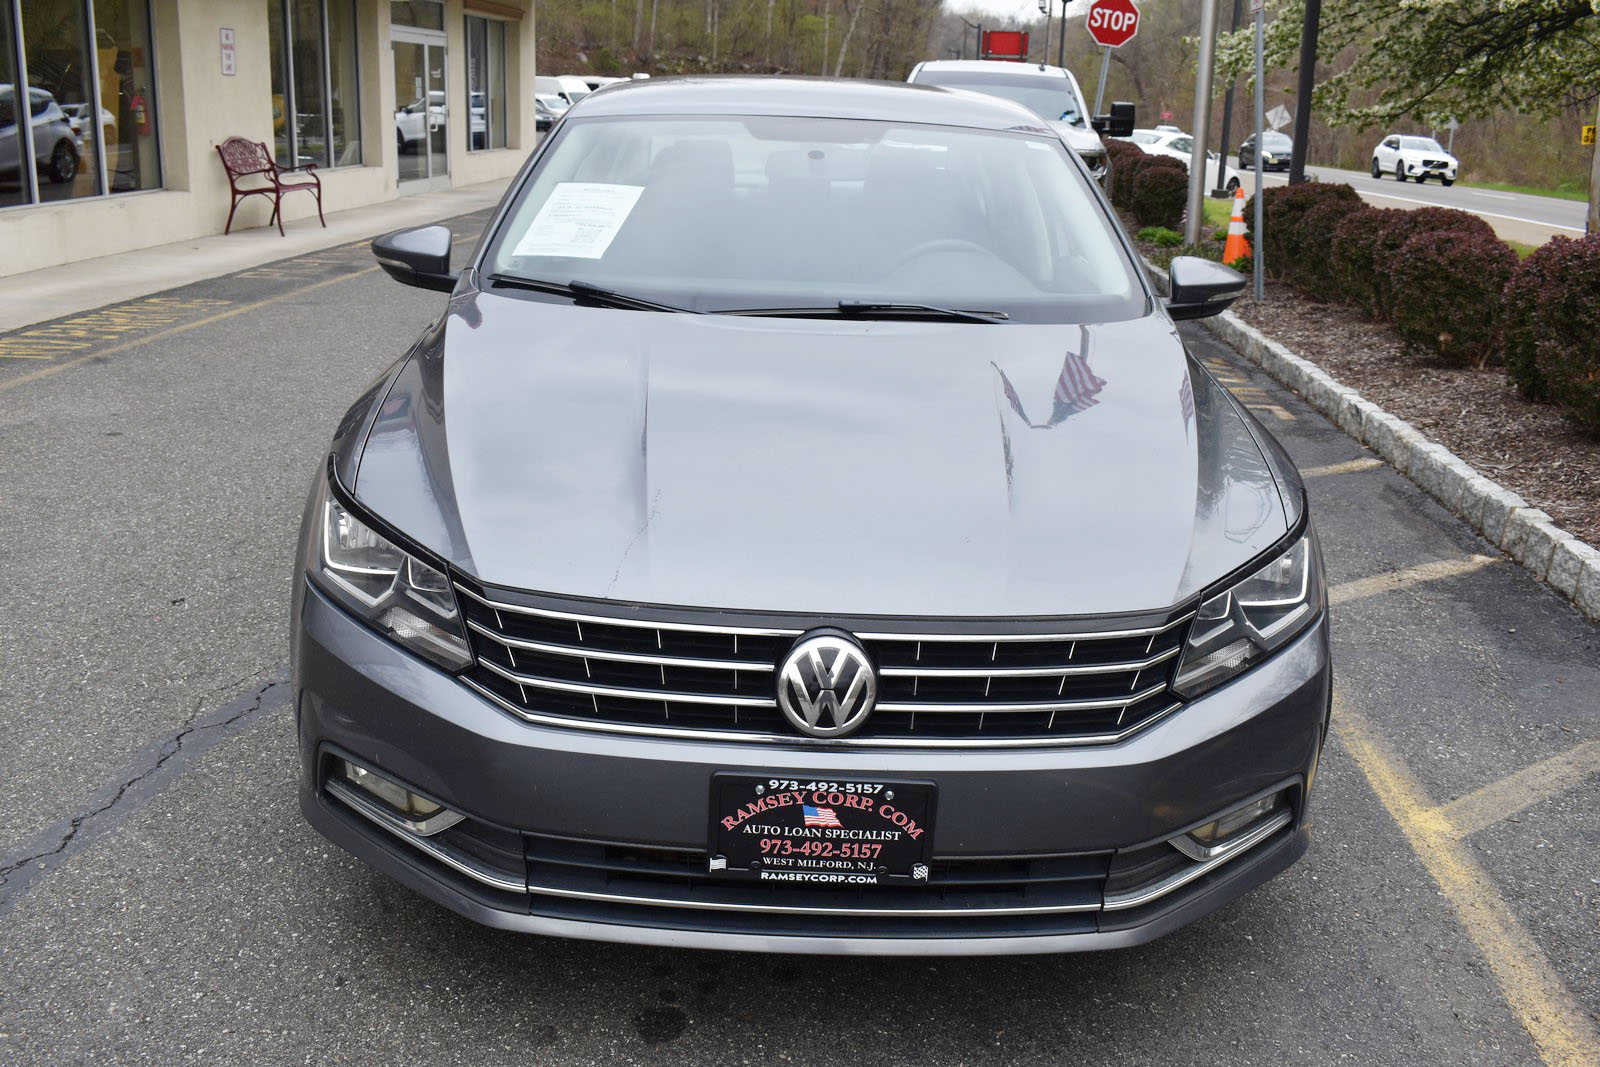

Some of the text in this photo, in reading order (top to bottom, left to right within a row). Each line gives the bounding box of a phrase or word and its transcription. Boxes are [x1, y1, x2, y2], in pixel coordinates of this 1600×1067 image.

[1090, 7, 1136, 32] STOP
[769, 779, 883, 794] 973-492-5157
[720, 790, 924, 840] RAMSEY CORP. COM
[742, 824, 901, 841] AUTO LOAN SPECIALIST
[760, 838, 882, 859] 973-492-5157
[763, 857, 877, 870] WEST MILFORD, N.J.
[760, 872, 878, 884] RAMSEYCORP.COM
